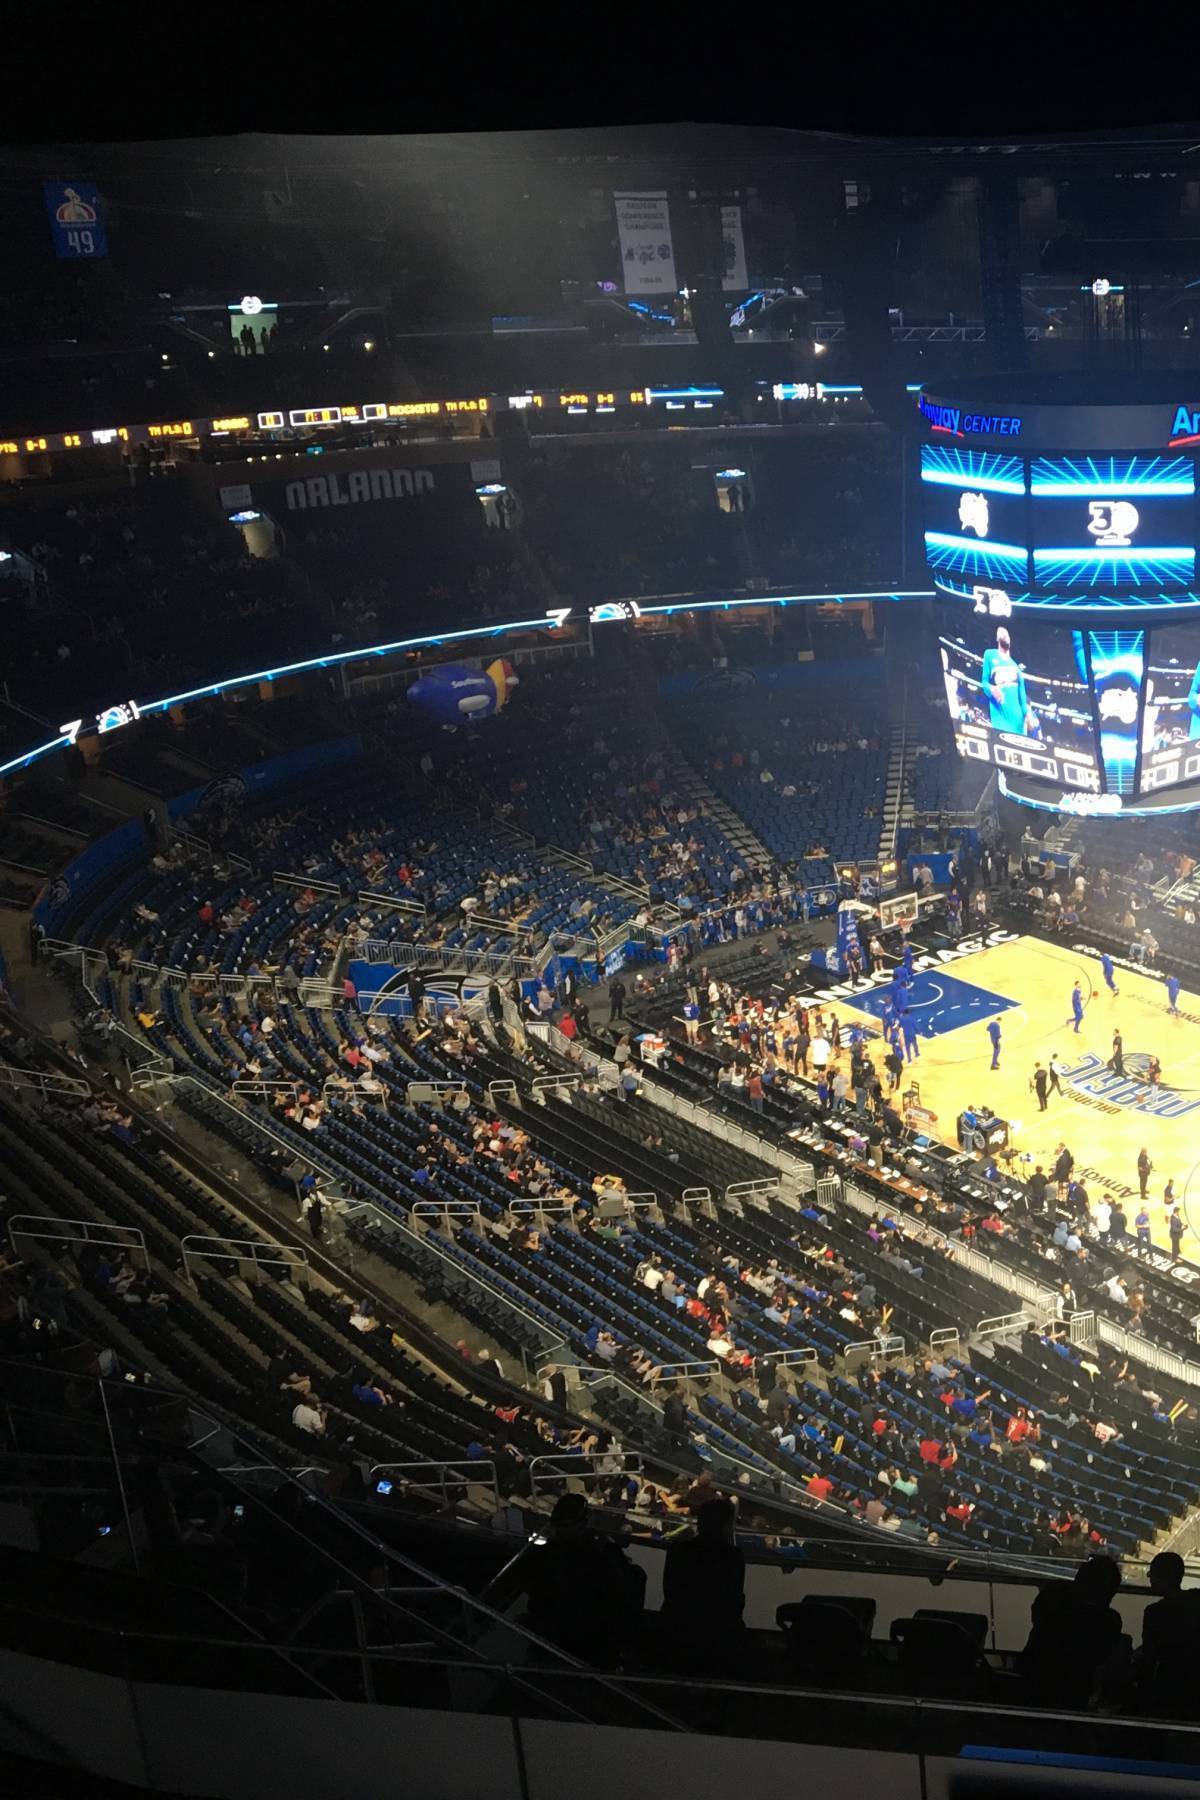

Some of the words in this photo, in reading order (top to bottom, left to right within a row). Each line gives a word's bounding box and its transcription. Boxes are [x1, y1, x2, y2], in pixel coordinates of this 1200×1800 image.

[68, 231, 94, 253] 49
[389, 403, 440, 416] ROCKETS
[963, 415, 1021, 435] CENTER
[285, 468, 435, 510] ORLANDO
[912, 930, 1019, 973] MAGIC
[1076, 1166, 1142, 1199] Amway
